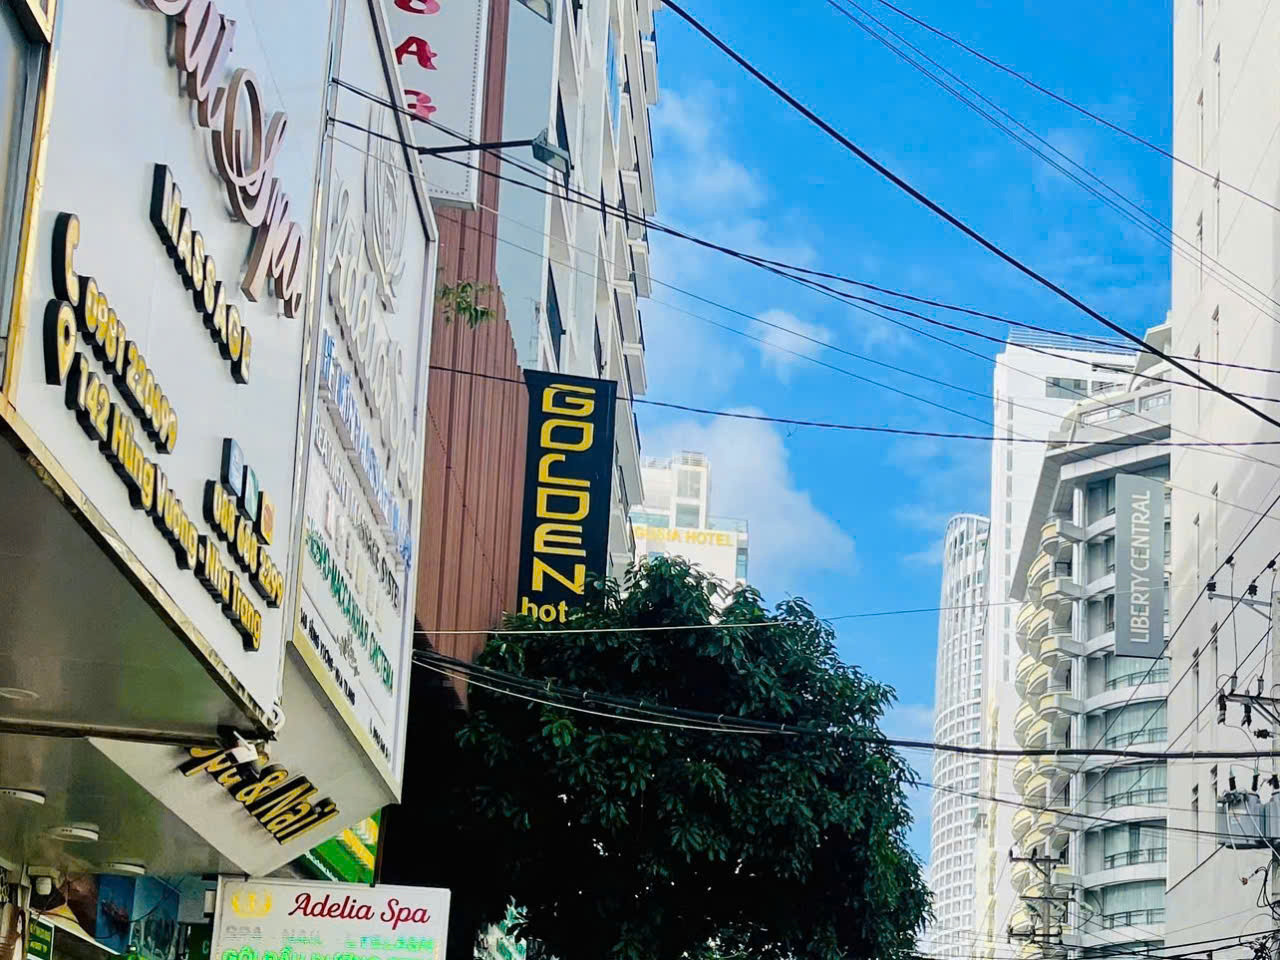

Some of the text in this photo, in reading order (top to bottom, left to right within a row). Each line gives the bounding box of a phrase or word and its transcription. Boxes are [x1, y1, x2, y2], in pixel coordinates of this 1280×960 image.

[151, 163, 252, 384] MASSAGE
[76, 352, 111, 447] 142
[111, 399, 156, 518] Hùng
[155, 468, 199, 575] Vương
[203, 536, 231, 608] Nha
[230, 568, 262, 656] Trang
[532, 383, 596, 595] GOLDEN
[685, 530, 736, 548] HOTEL
[521, 597, 568, 623] hot
[1130, 491, 1150, 643] LIBERTY CENTRAL
[248, 776, 340, 845] Nail
[288, 892, 431, 930] Adelia Spa
